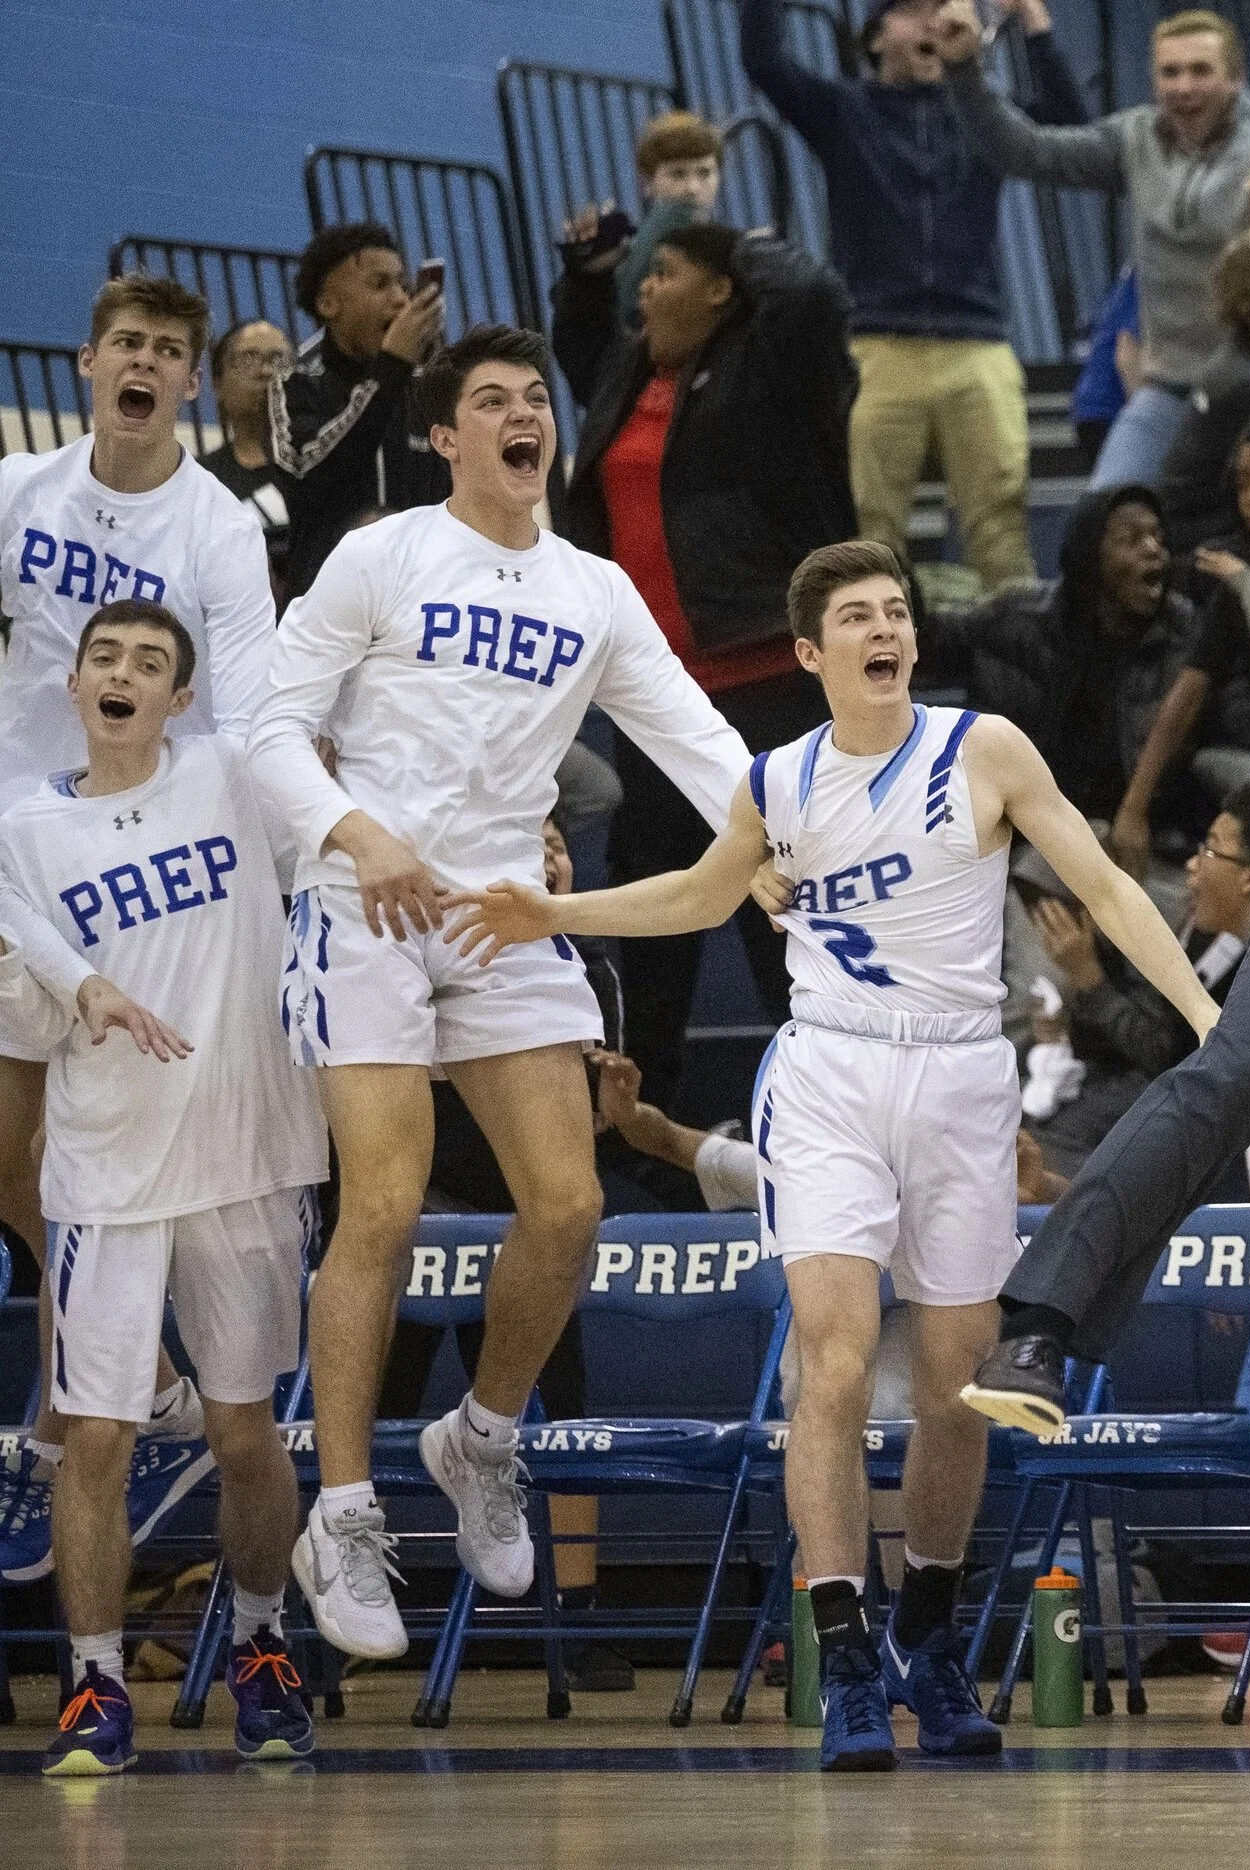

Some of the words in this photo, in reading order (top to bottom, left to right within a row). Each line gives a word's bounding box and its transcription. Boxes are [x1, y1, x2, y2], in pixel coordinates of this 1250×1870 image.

[19, 528, 166, 604] PREP
[416, 602, 585, 687] PREP
[59, 836, 238, 947] PREP
[789, 852, 912, 913] REP
[808, 917, 900, 988] 2
[406, 1244, 502, 1296] RE
[590, 1240, 760, 1294] PREP
[532, 1428, 612, 1451] JAYS
[1084, 1421, 1161, 1443] JAYS
[1054, 1609, 1081, 1643] G
